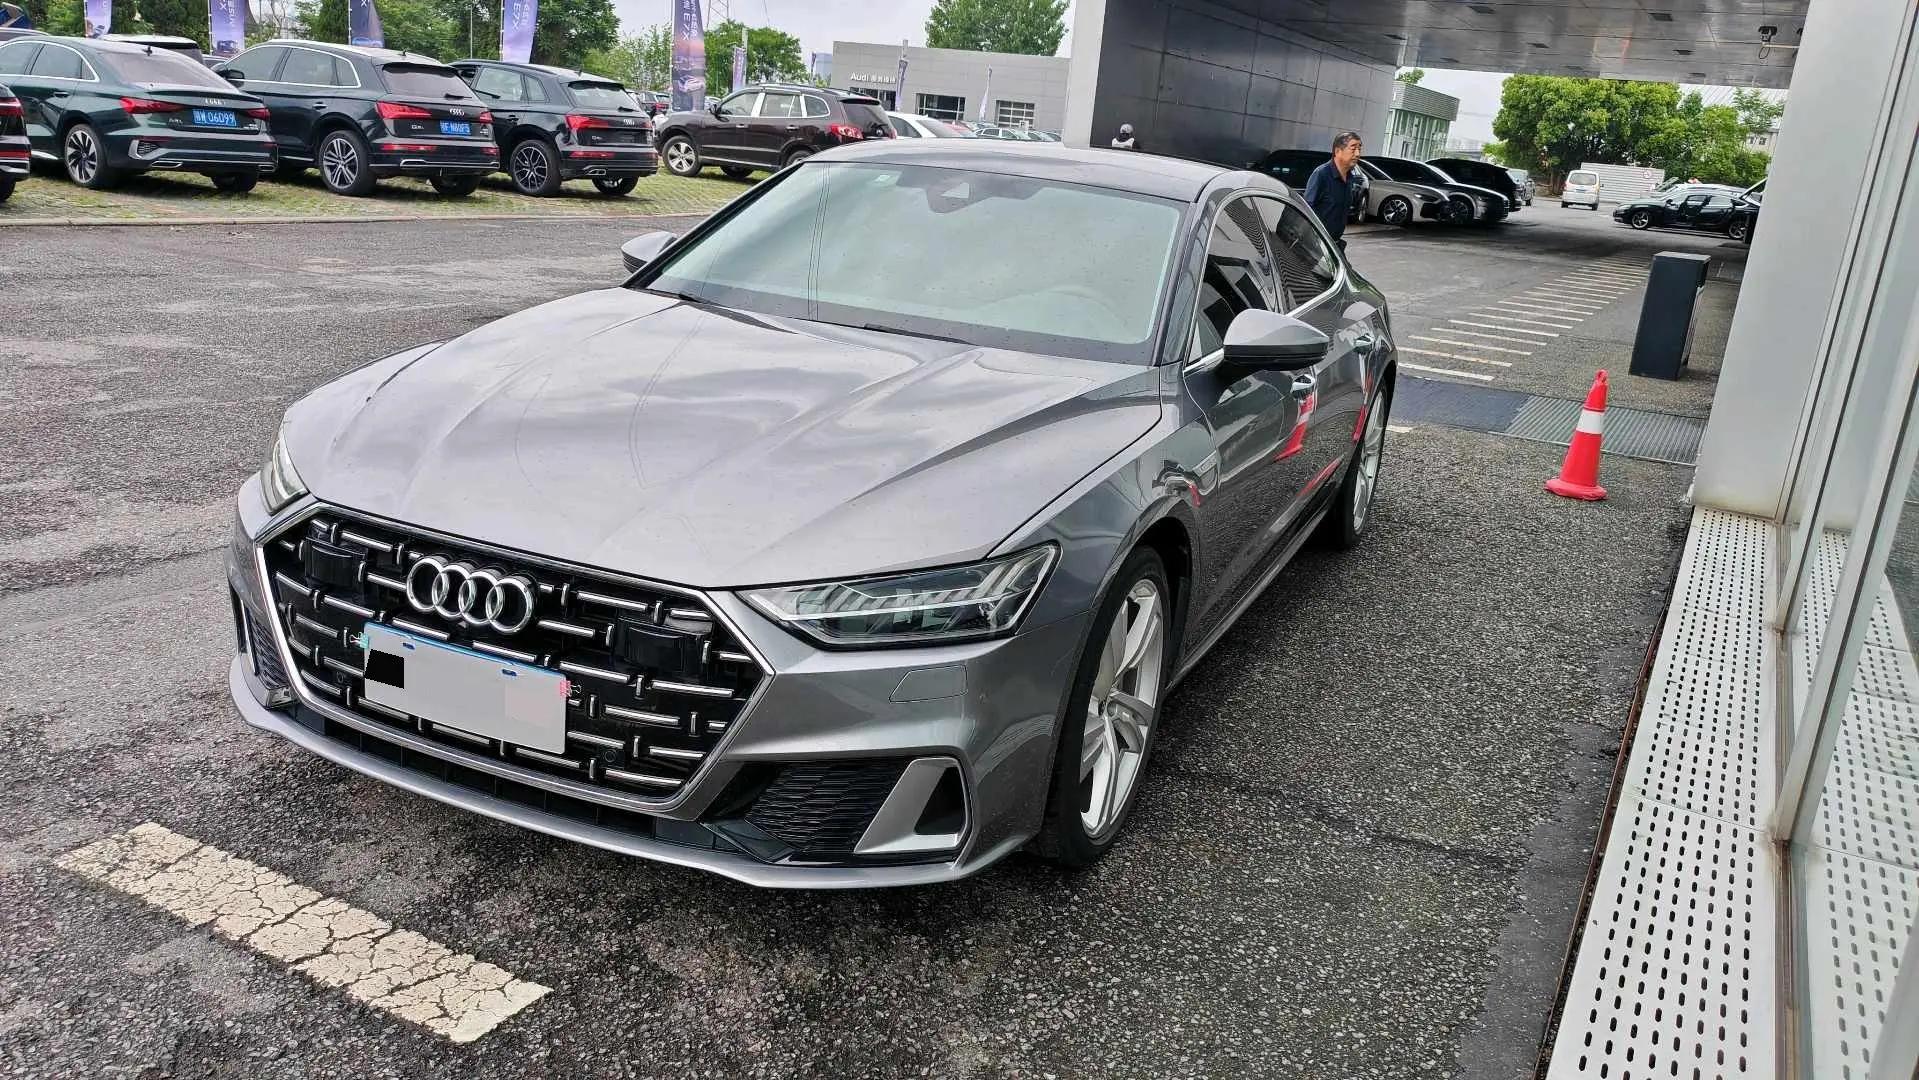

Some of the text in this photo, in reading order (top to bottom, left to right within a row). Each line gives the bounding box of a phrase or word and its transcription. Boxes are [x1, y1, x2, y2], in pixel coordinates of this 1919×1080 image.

[512, 2, 521, 30] E7X
[682, 12, 691, 41] E7X
[850, 72, 869, 82] Audi
